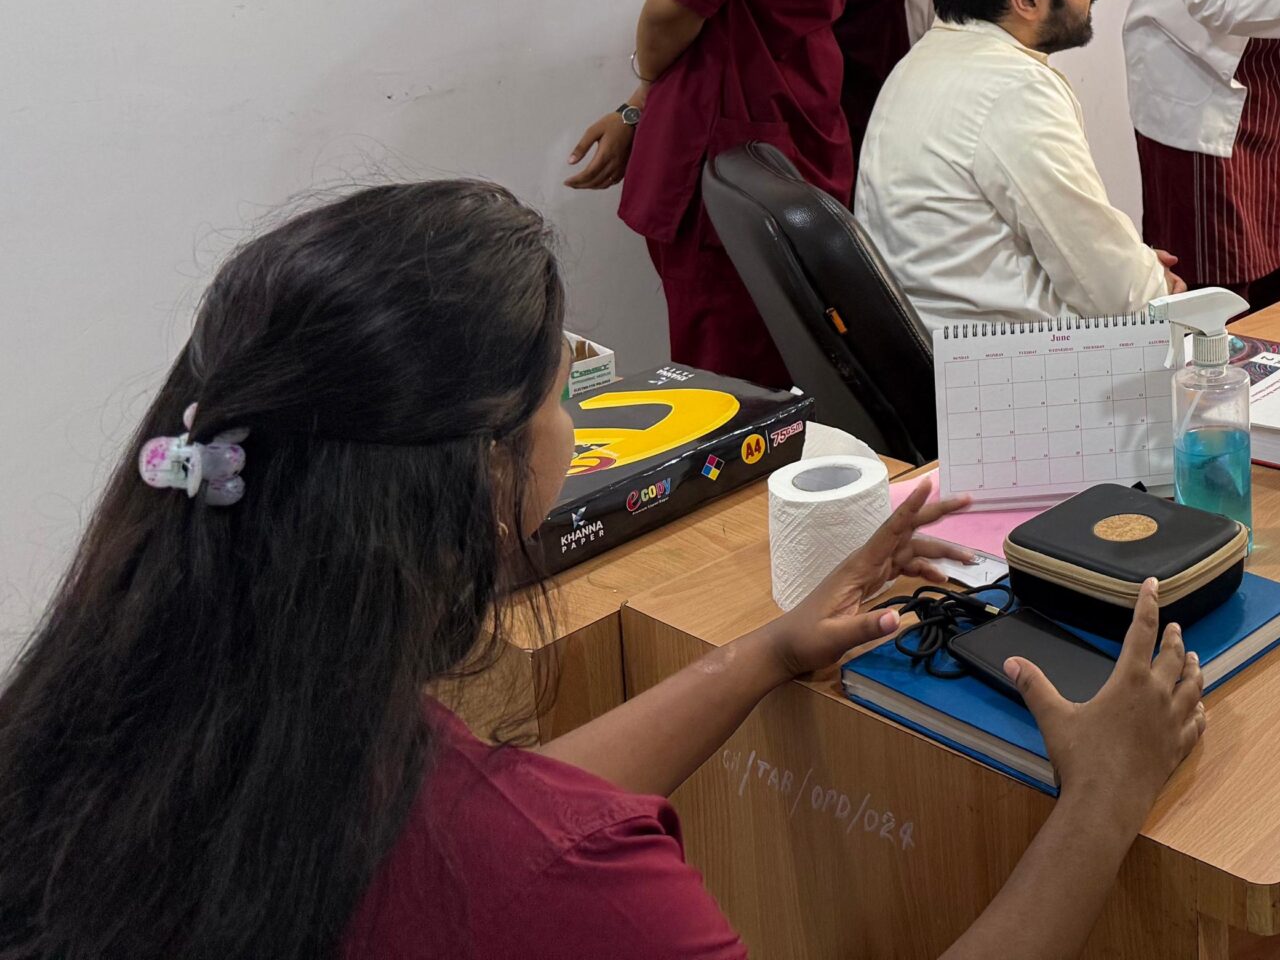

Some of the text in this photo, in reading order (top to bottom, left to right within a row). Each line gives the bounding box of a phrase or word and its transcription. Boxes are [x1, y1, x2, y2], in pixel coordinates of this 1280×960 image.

[1050, 333, 1071, 342] June
[745, 437, 762, 460] A4
[560, 520, 604, 546] KHANNA
[561, 529, 605, 554] PAPER
